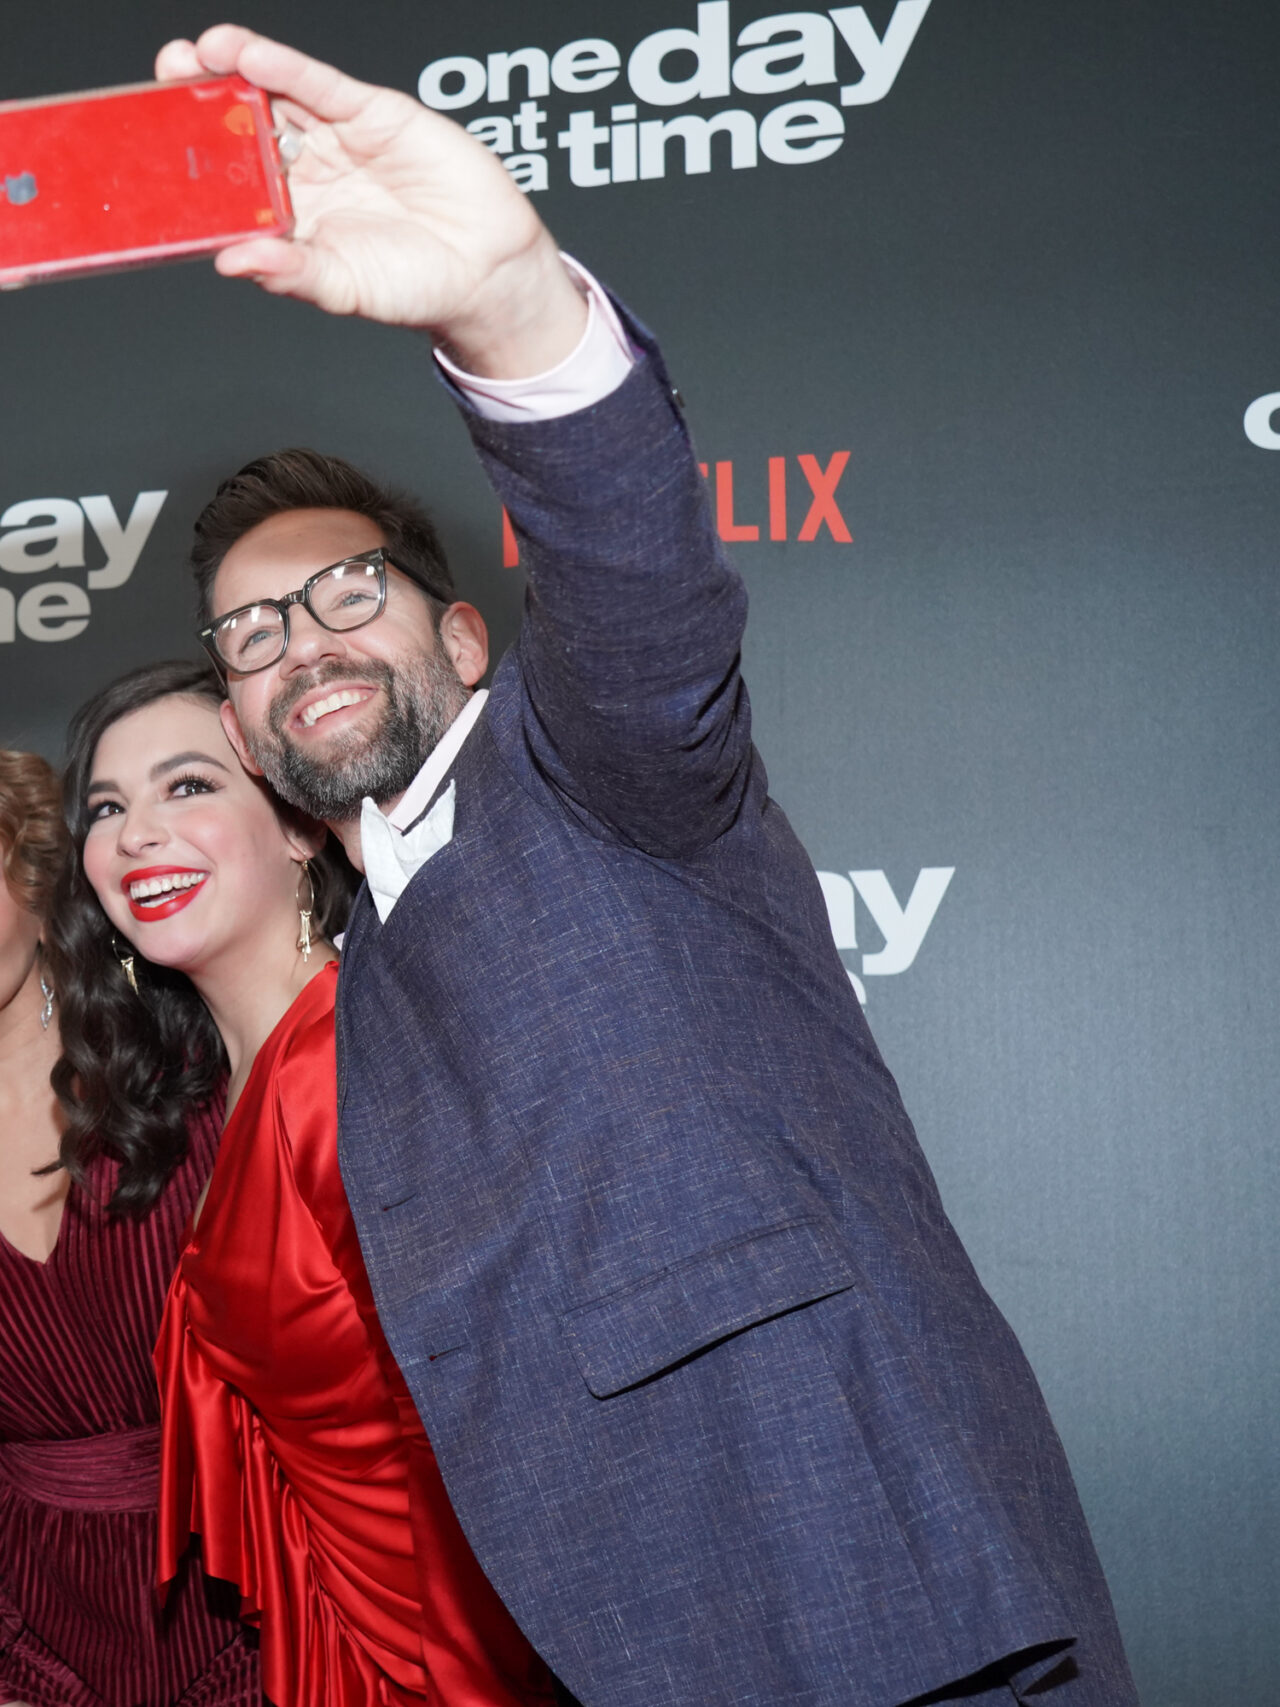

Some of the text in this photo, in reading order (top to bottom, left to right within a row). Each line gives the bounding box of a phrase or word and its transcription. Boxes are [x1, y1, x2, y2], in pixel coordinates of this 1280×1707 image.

[418, 0, 931, 110] one day
[465, 100, 548, 154] at
[502, 100, 845, 193] a time
